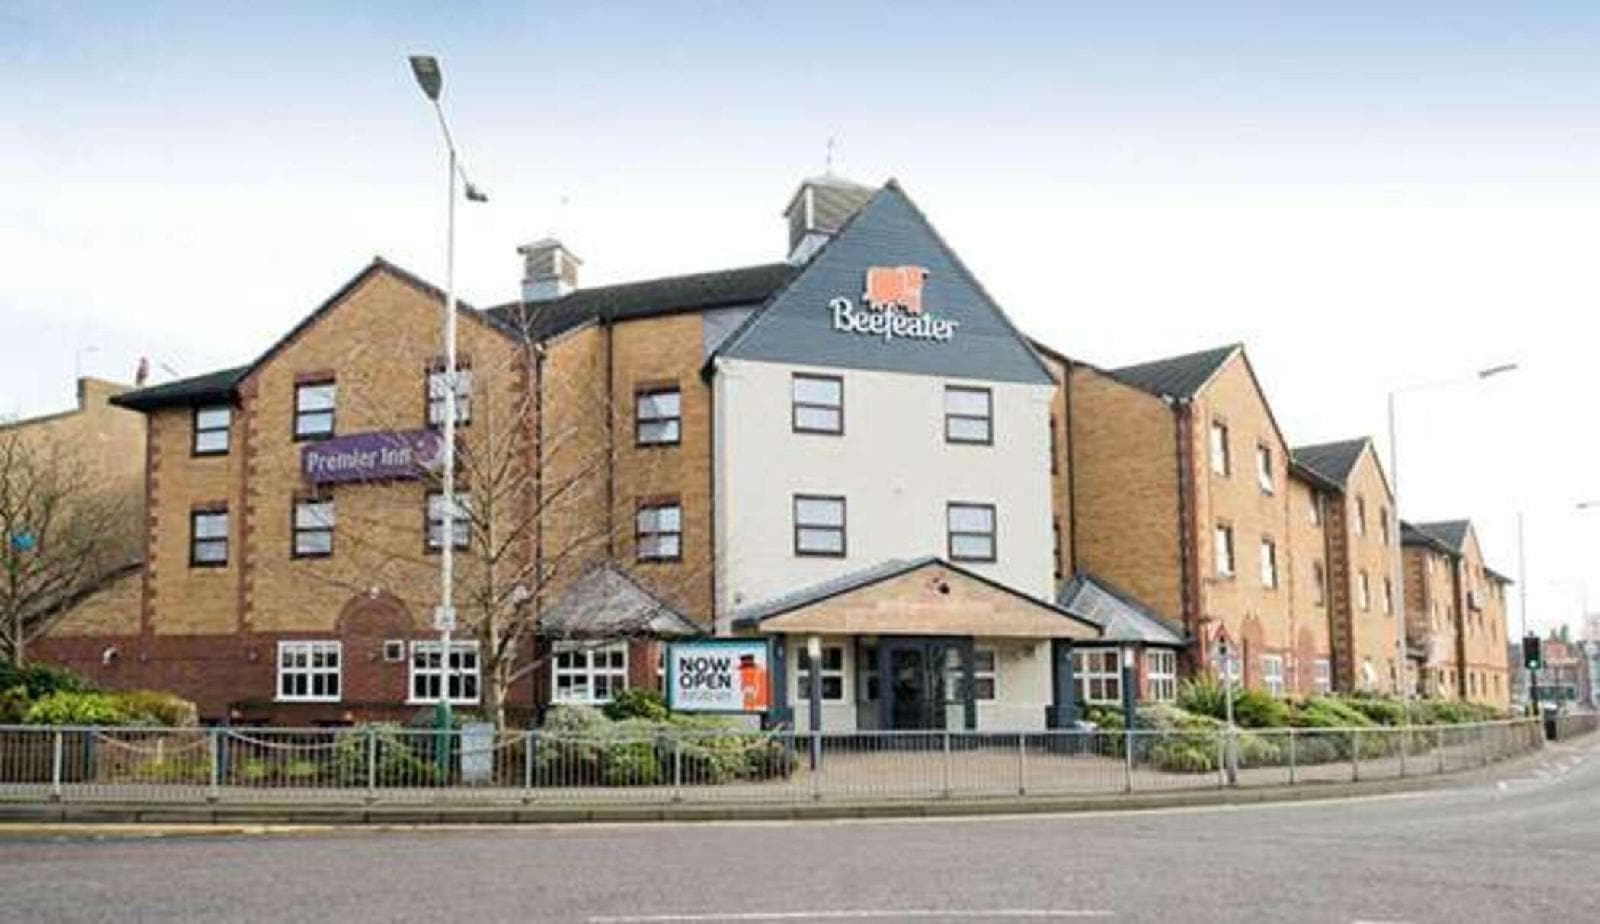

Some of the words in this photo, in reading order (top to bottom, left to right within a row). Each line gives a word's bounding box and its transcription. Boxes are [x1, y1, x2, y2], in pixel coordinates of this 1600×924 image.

[829, 297, 958, 340] Beefeater
[308, 449, 376, 472] Premier
[381, 448, 413, 466] Inn
[679, 657, 731, 672] NOW
[679, 673, 731, 689] OPEN
